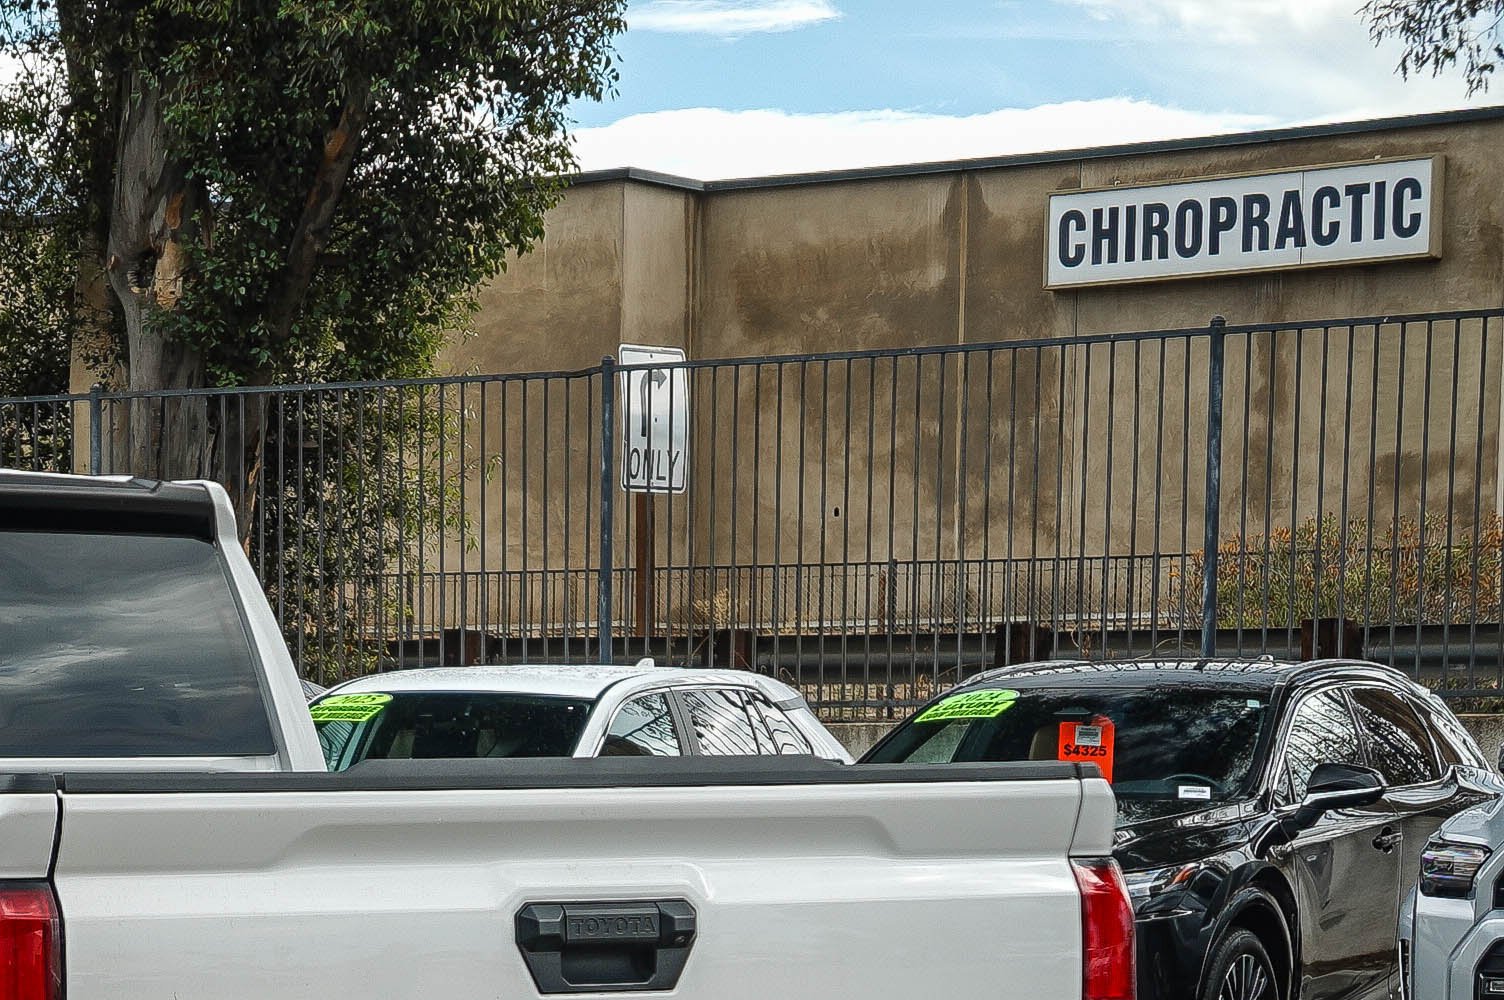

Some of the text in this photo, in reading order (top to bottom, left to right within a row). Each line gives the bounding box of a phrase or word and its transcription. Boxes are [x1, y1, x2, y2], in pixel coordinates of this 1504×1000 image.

[1058, 177, 1423, 269] CHIROPRACTIC
[629, 447, 681, 481] ONLY
[1063, 743, 1107, 756] $4325
[570, 915, 657, 936] TOYOTA
